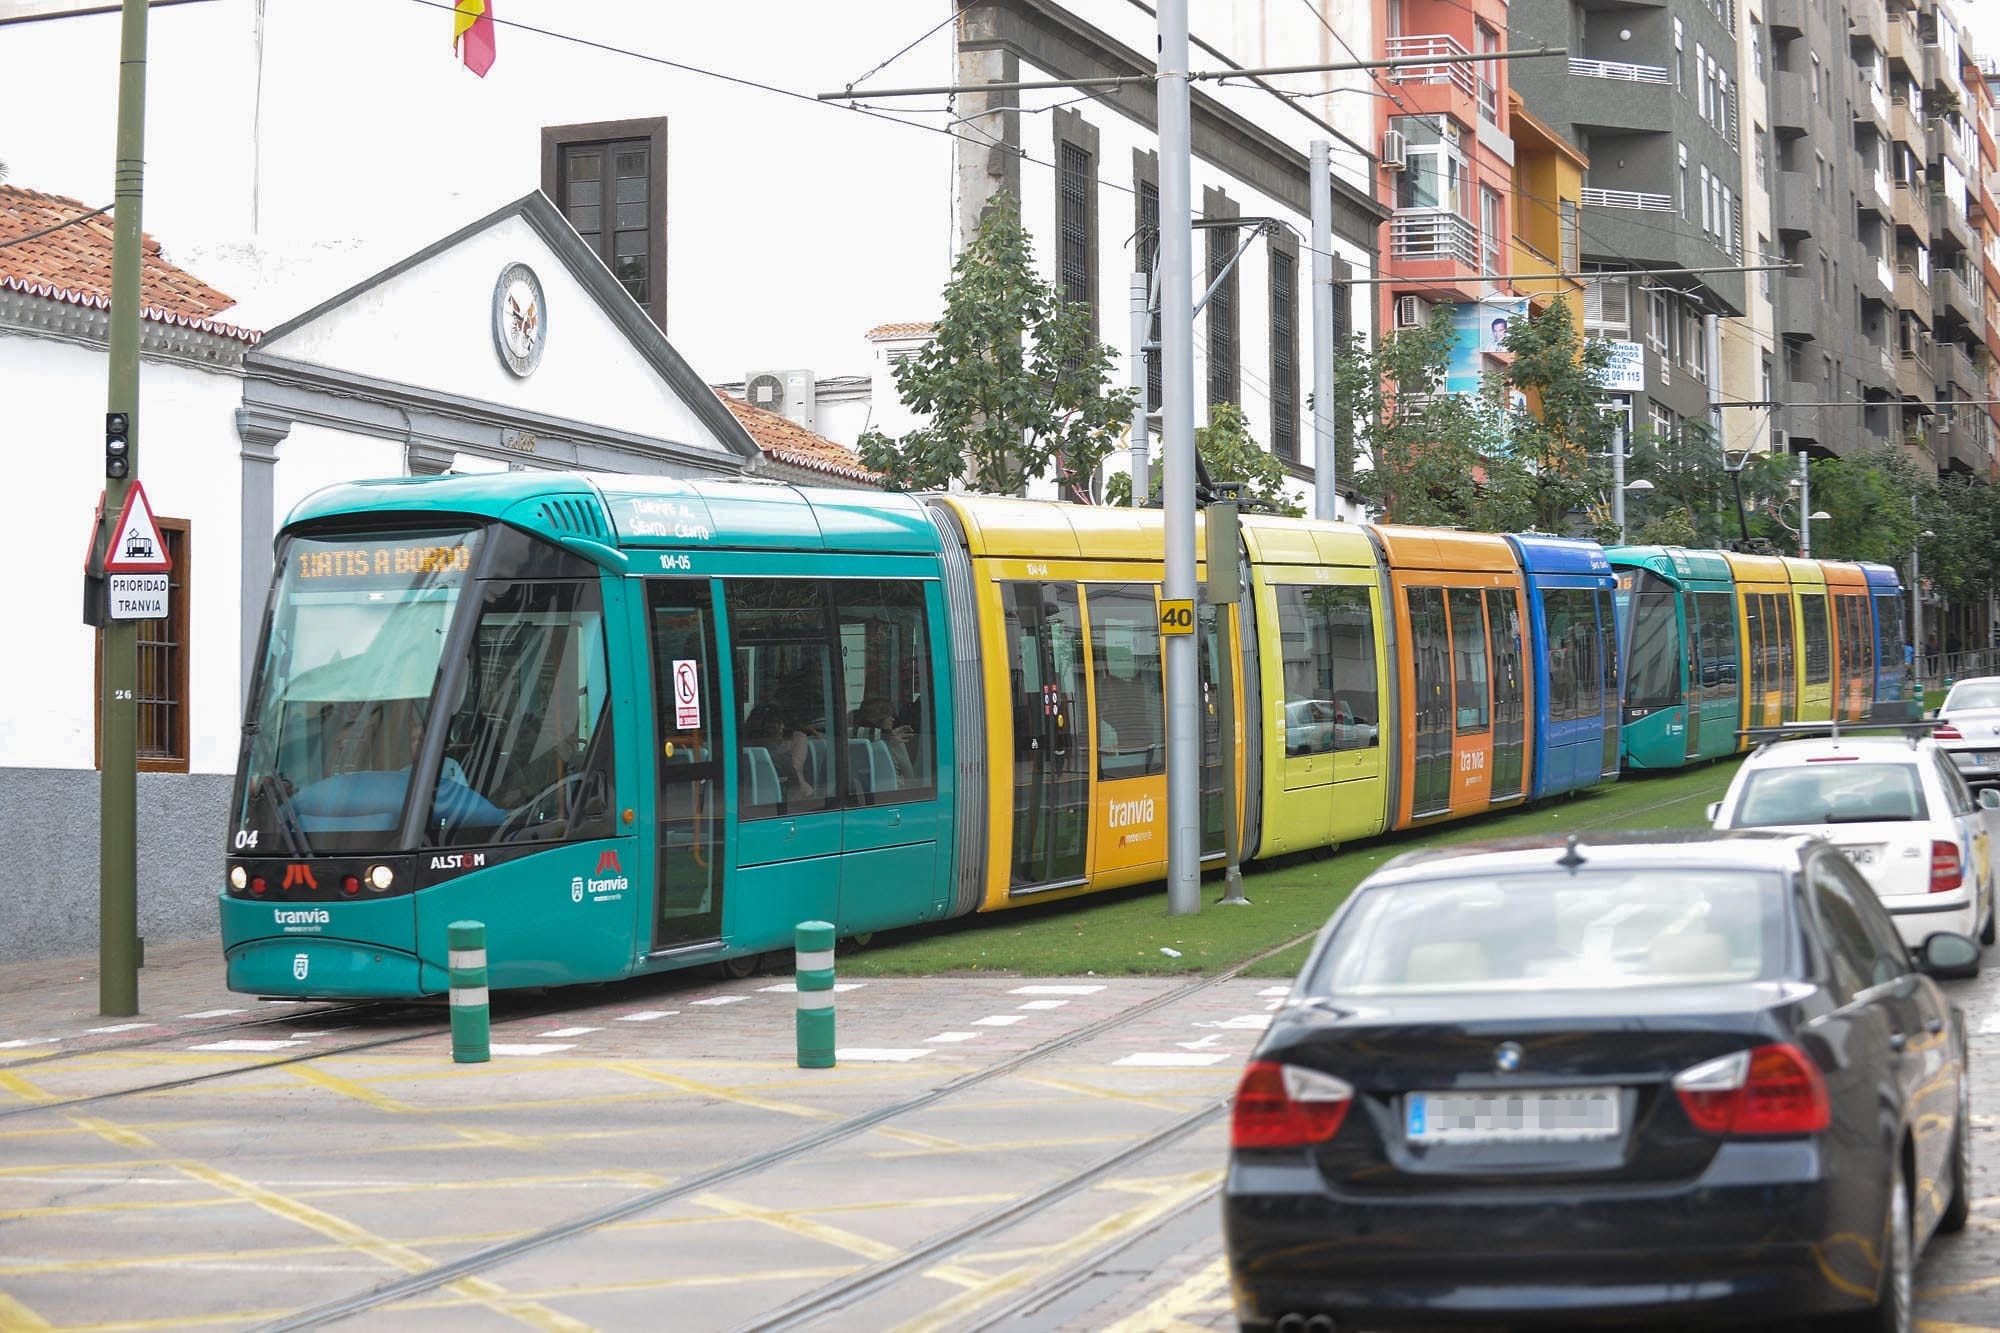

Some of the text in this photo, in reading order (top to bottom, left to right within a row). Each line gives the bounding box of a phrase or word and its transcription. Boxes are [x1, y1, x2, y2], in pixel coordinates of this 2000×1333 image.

[374, 548, 391, 575] A
[394, 545, 471, 574] BORDO
[659, 554, 691, 570] 104-05
[112, 579, 168, 593] PRIORIDAD
[118, 599, 162, 613] TRANVIA
[1162, 607, 1193, 627] 40
[114, 689, 132, 700] 26
[1109, 793, 1154, 829] tranvía
[234, 829, 259, 849] 04
[430, 852, 485, 870] ALSTOM
[587, 876, 628, 893] tranvía
[273, 908, 331, 924] tranvía
